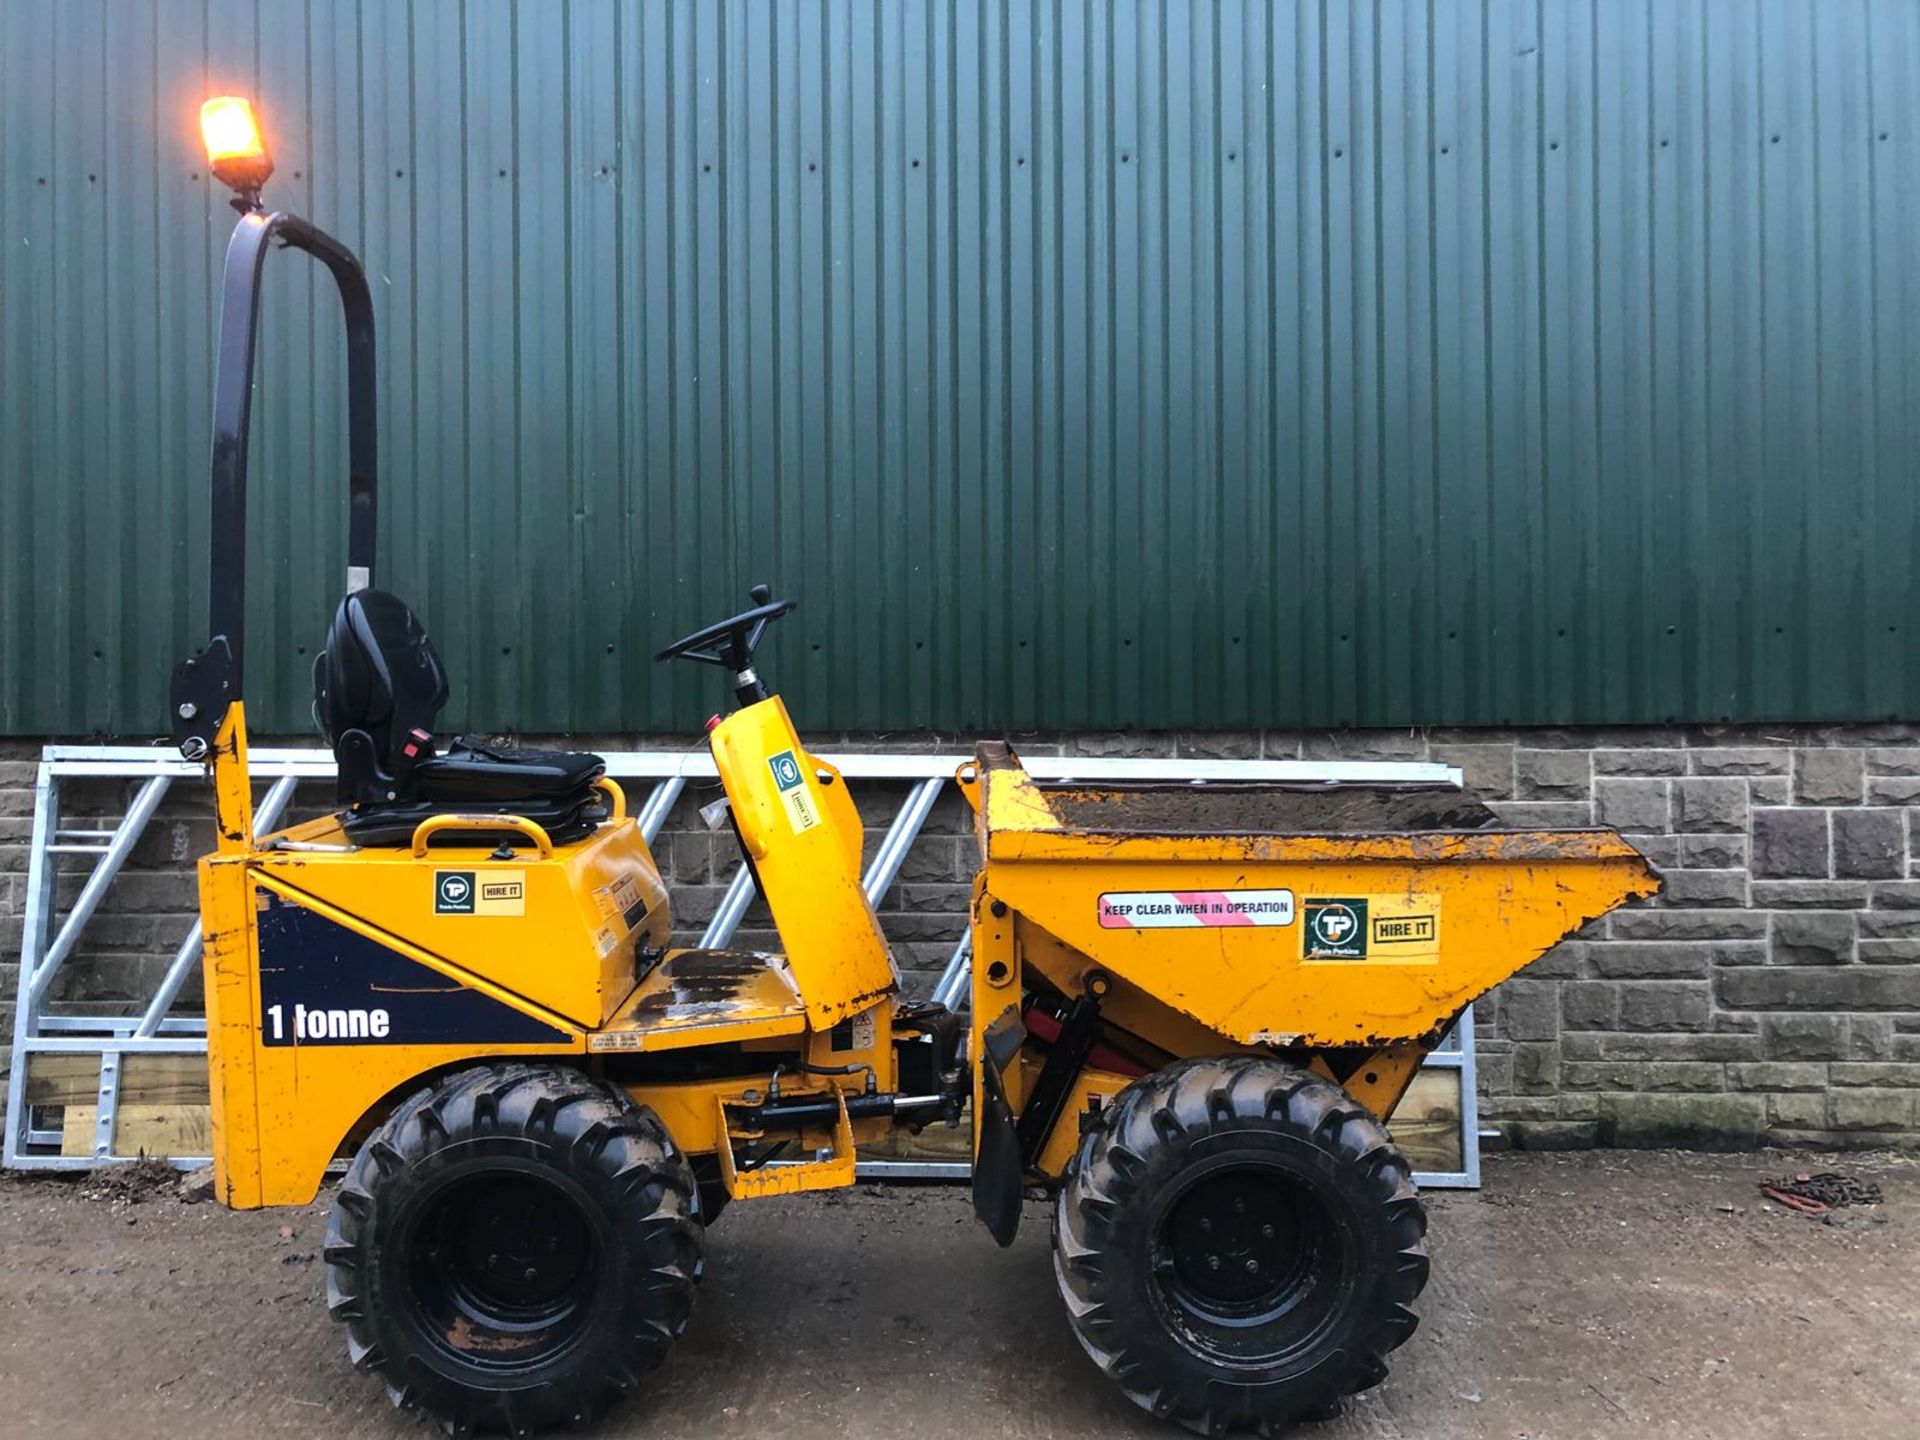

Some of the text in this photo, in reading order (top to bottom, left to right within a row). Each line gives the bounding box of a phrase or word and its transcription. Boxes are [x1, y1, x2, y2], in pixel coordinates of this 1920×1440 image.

[446, 883, 466, 897] TP
[486, 886, 518, 896] HIRE IT
[1104, 902, 1288, 916] KEEP CLEAR WHEN IN OPERATION
[1322, 915, 1352, 937] TP
[1379, 922, 1428, 937] HIRE IT
[268, 1003, 390, 1039] 1 tonne
